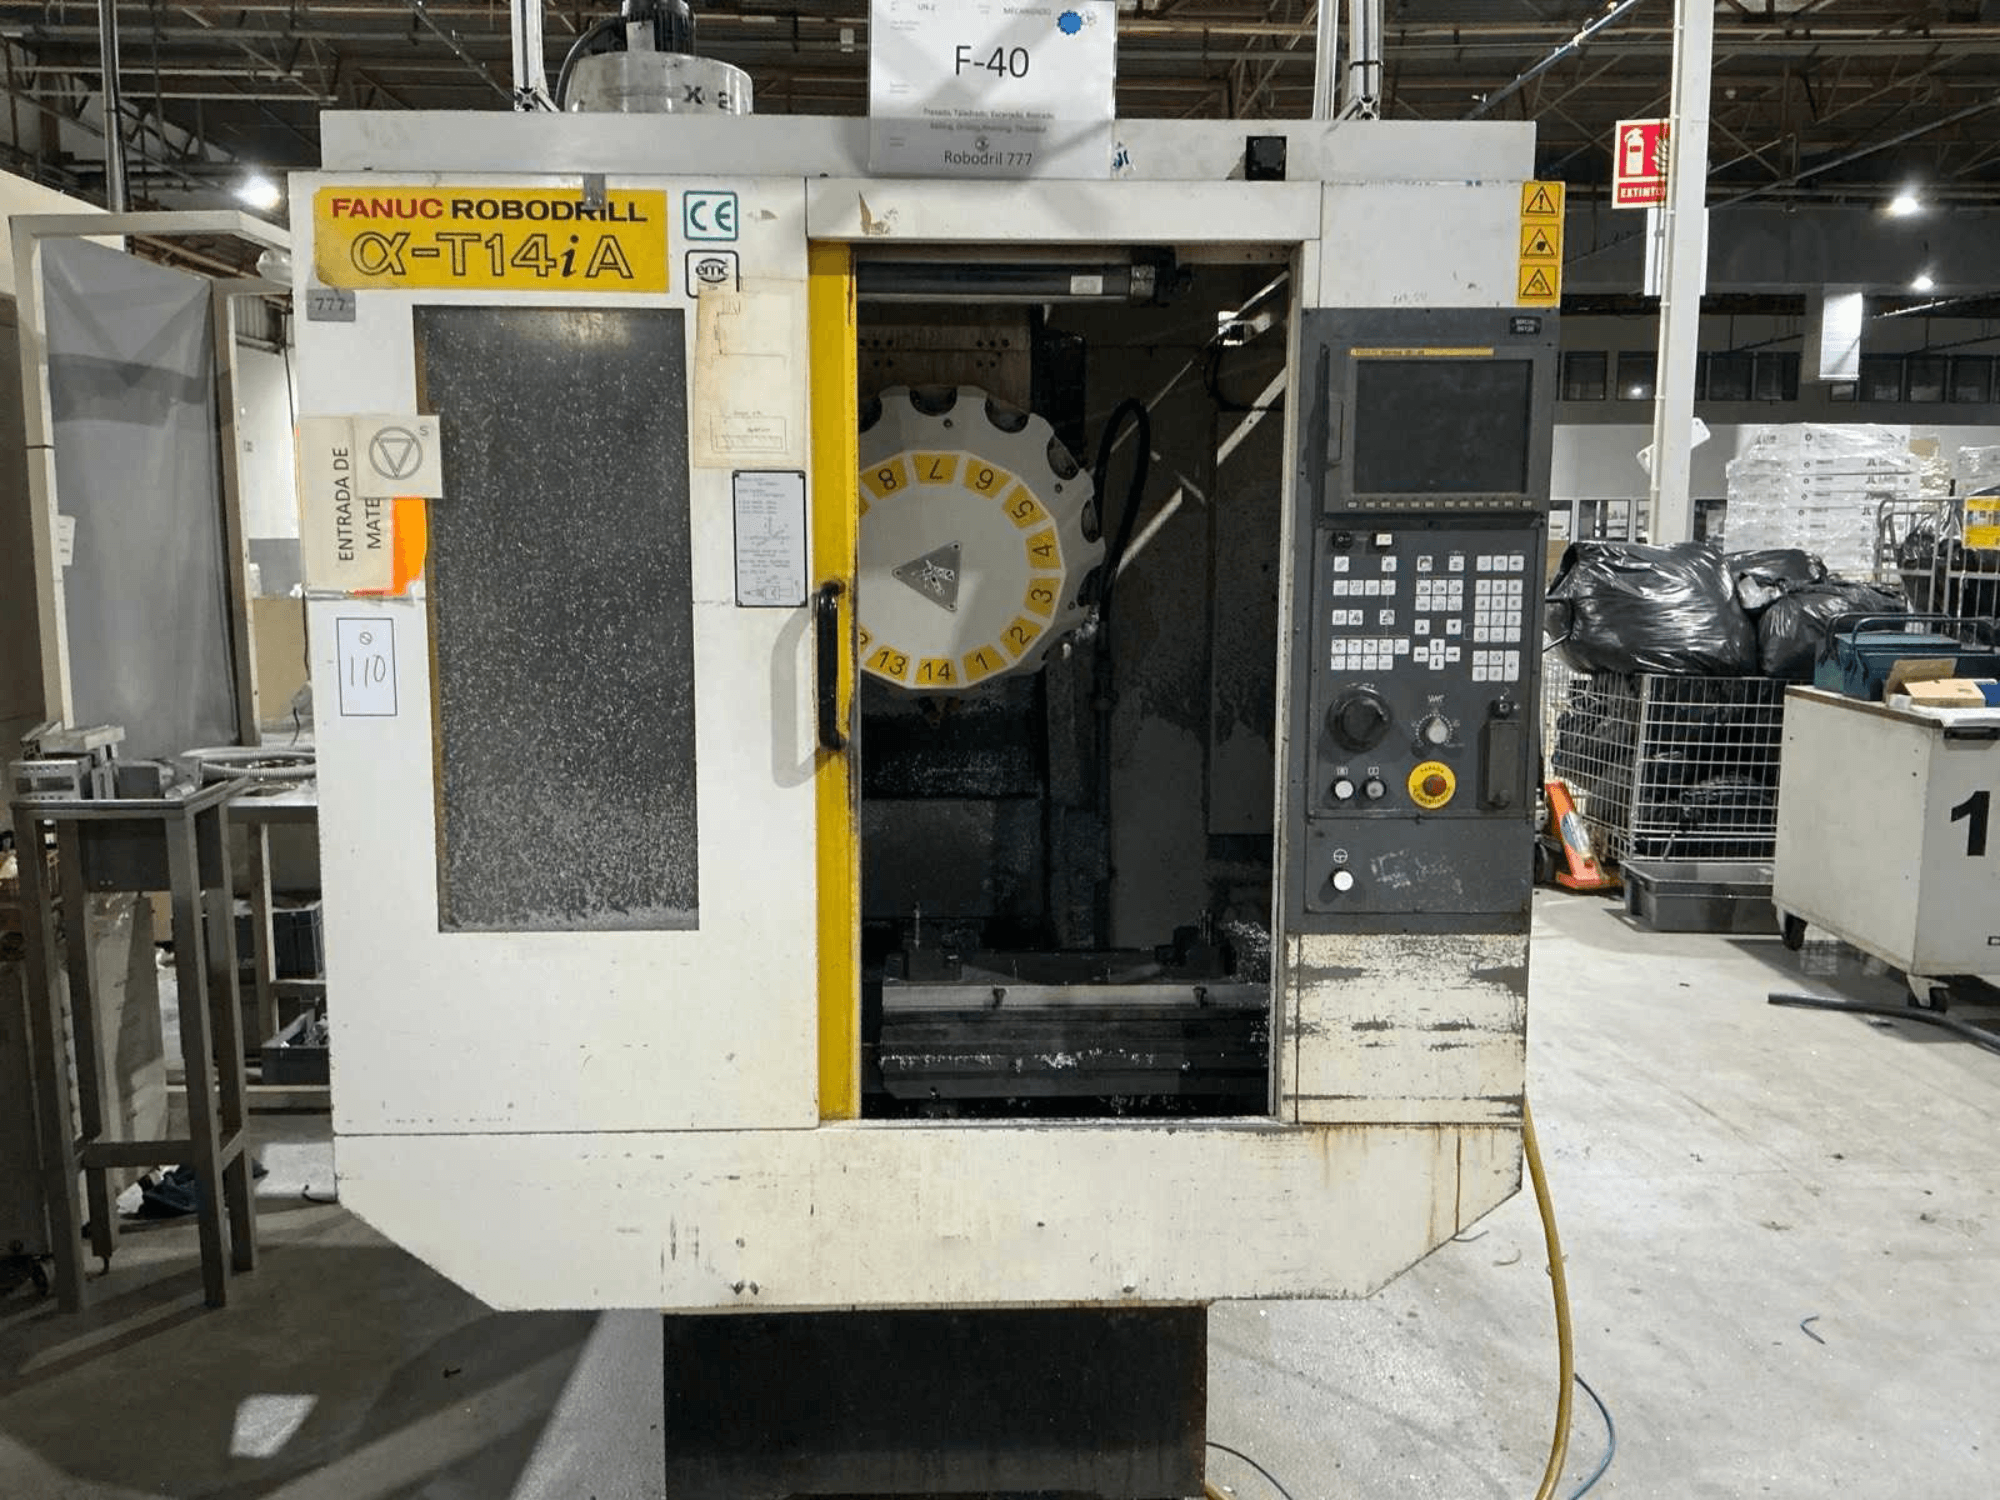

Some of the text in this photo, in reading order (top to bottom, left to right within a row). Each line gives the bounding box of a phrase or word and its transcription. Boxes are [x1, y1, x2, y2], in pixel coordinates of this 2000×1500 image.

[955, 45, 1031, 78] F-40
[944, 150, 1034, 166] Robodril 777
[332, 198, 648, 222] FANUC ROBODRILL
[690, 200, 732, 232] CE
[315, 298, 347, 312] 777
[877, 467, 898, 491] 8
[928, 458, 944, 480] 7
[333, 447, 355, 561] ENTRADA DE
[1011, 499, 1035, 519] 5
[366, 498, 382, 550] MATE
[1033, 544, 1053, 558] 4
[1030, 588, 1053, 604] 3
[1010, 626, 1031, 646] 2
[349, 653, 387, 688] 110
[878, 650, 907, 675] 13
[922, 662, 950, 681] 14
[975, 653, 989, 671] 1
[1950, 790, 1991, 857] 1
